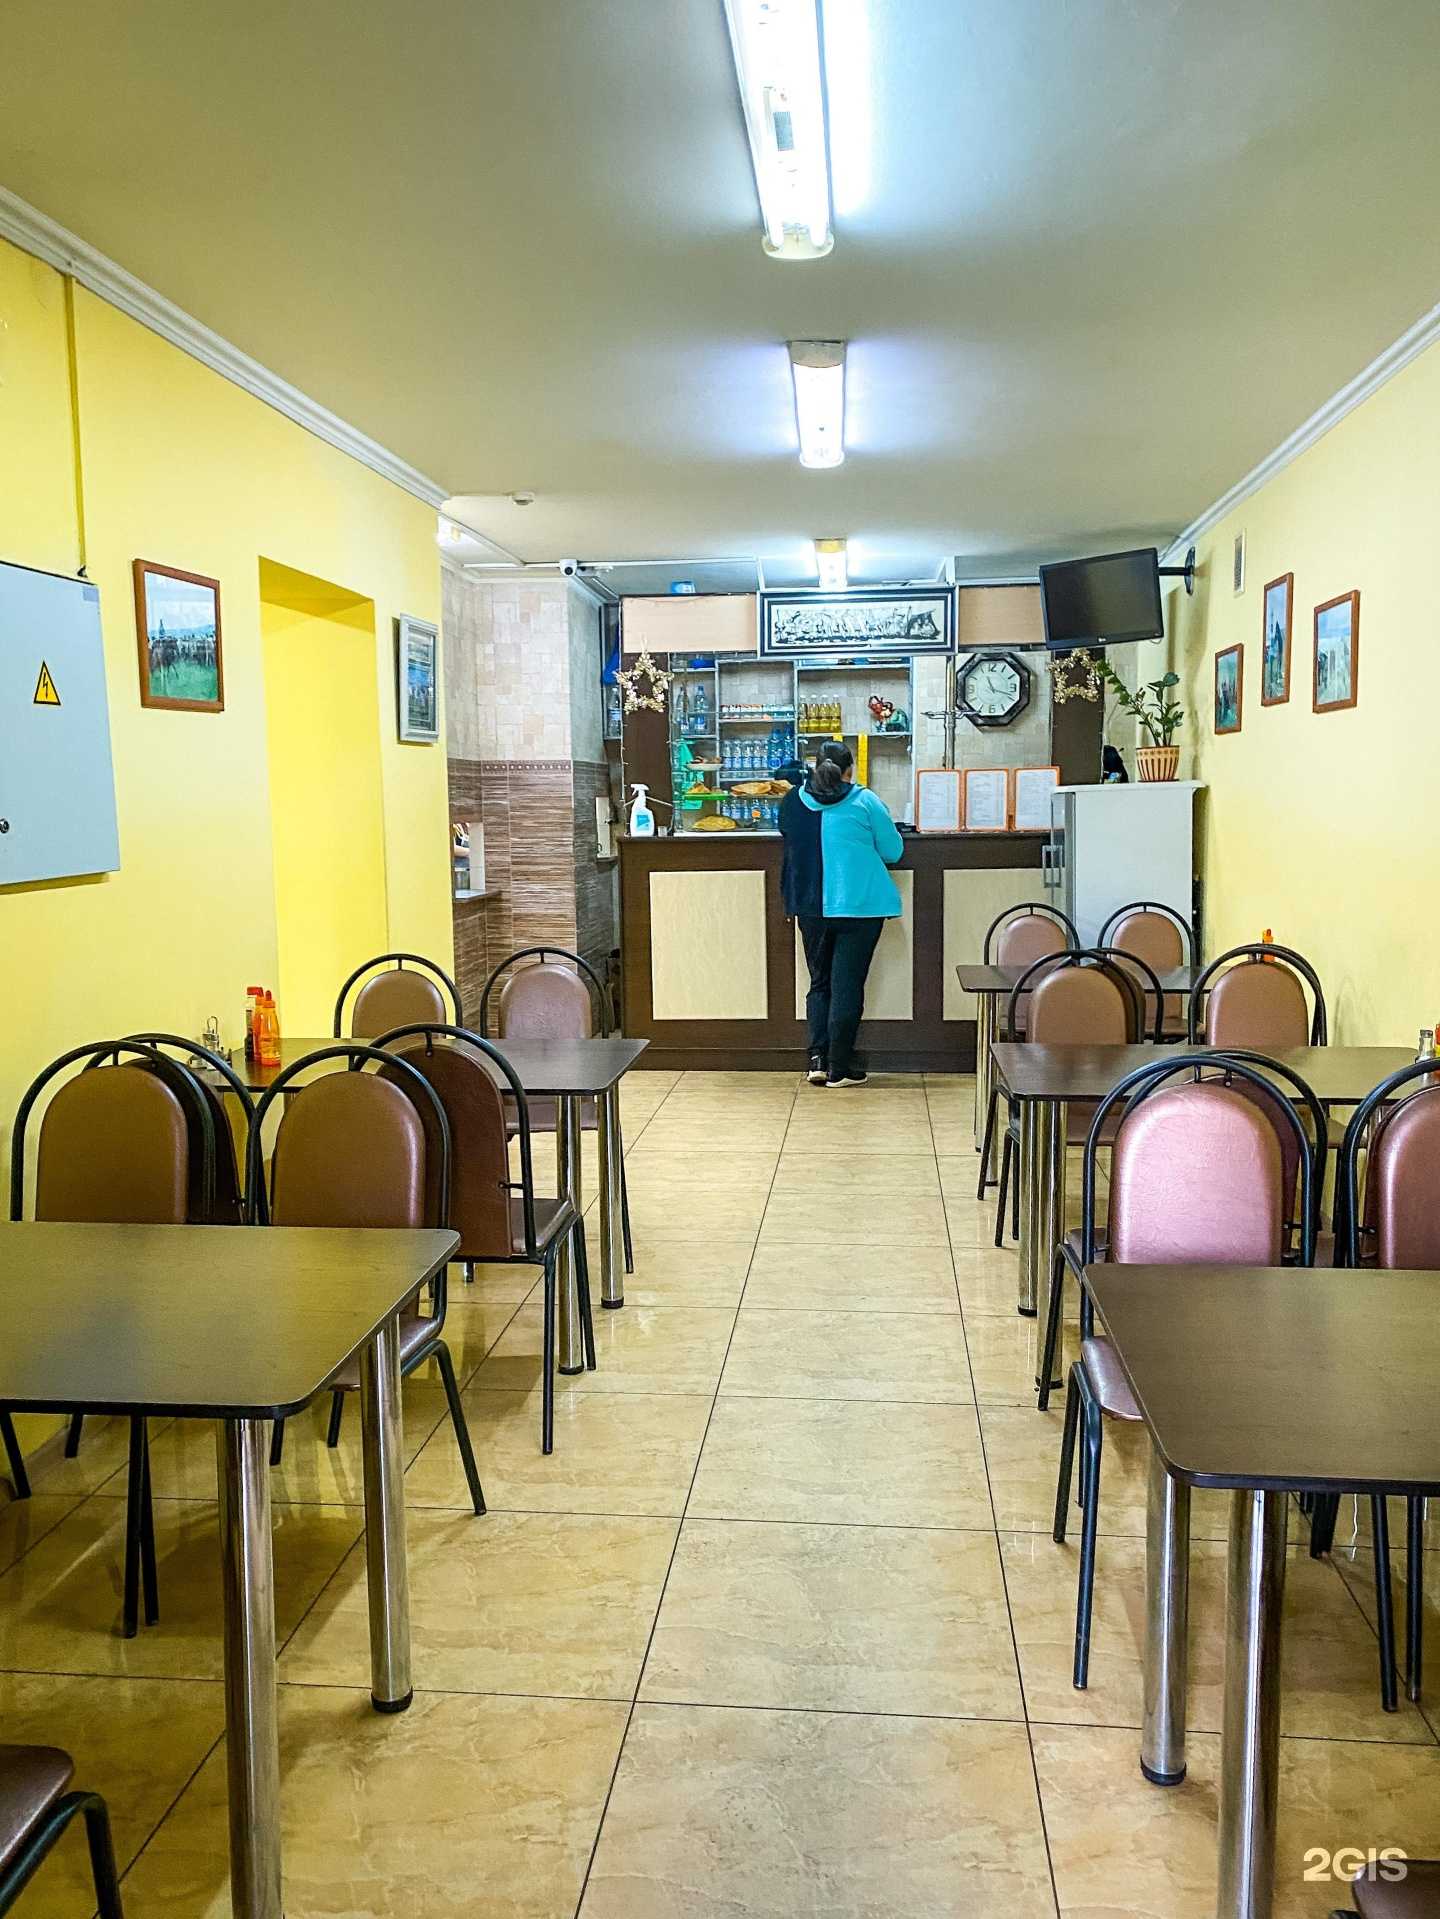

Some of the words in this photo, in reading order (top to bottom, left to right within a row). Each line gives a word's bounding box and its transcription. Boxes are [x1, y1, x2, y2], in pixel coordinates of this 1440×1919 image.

[988, 663, 997, 672] 12
[1009, 683, 1017, 692] 3
[988, 704, 996, 714] 6
